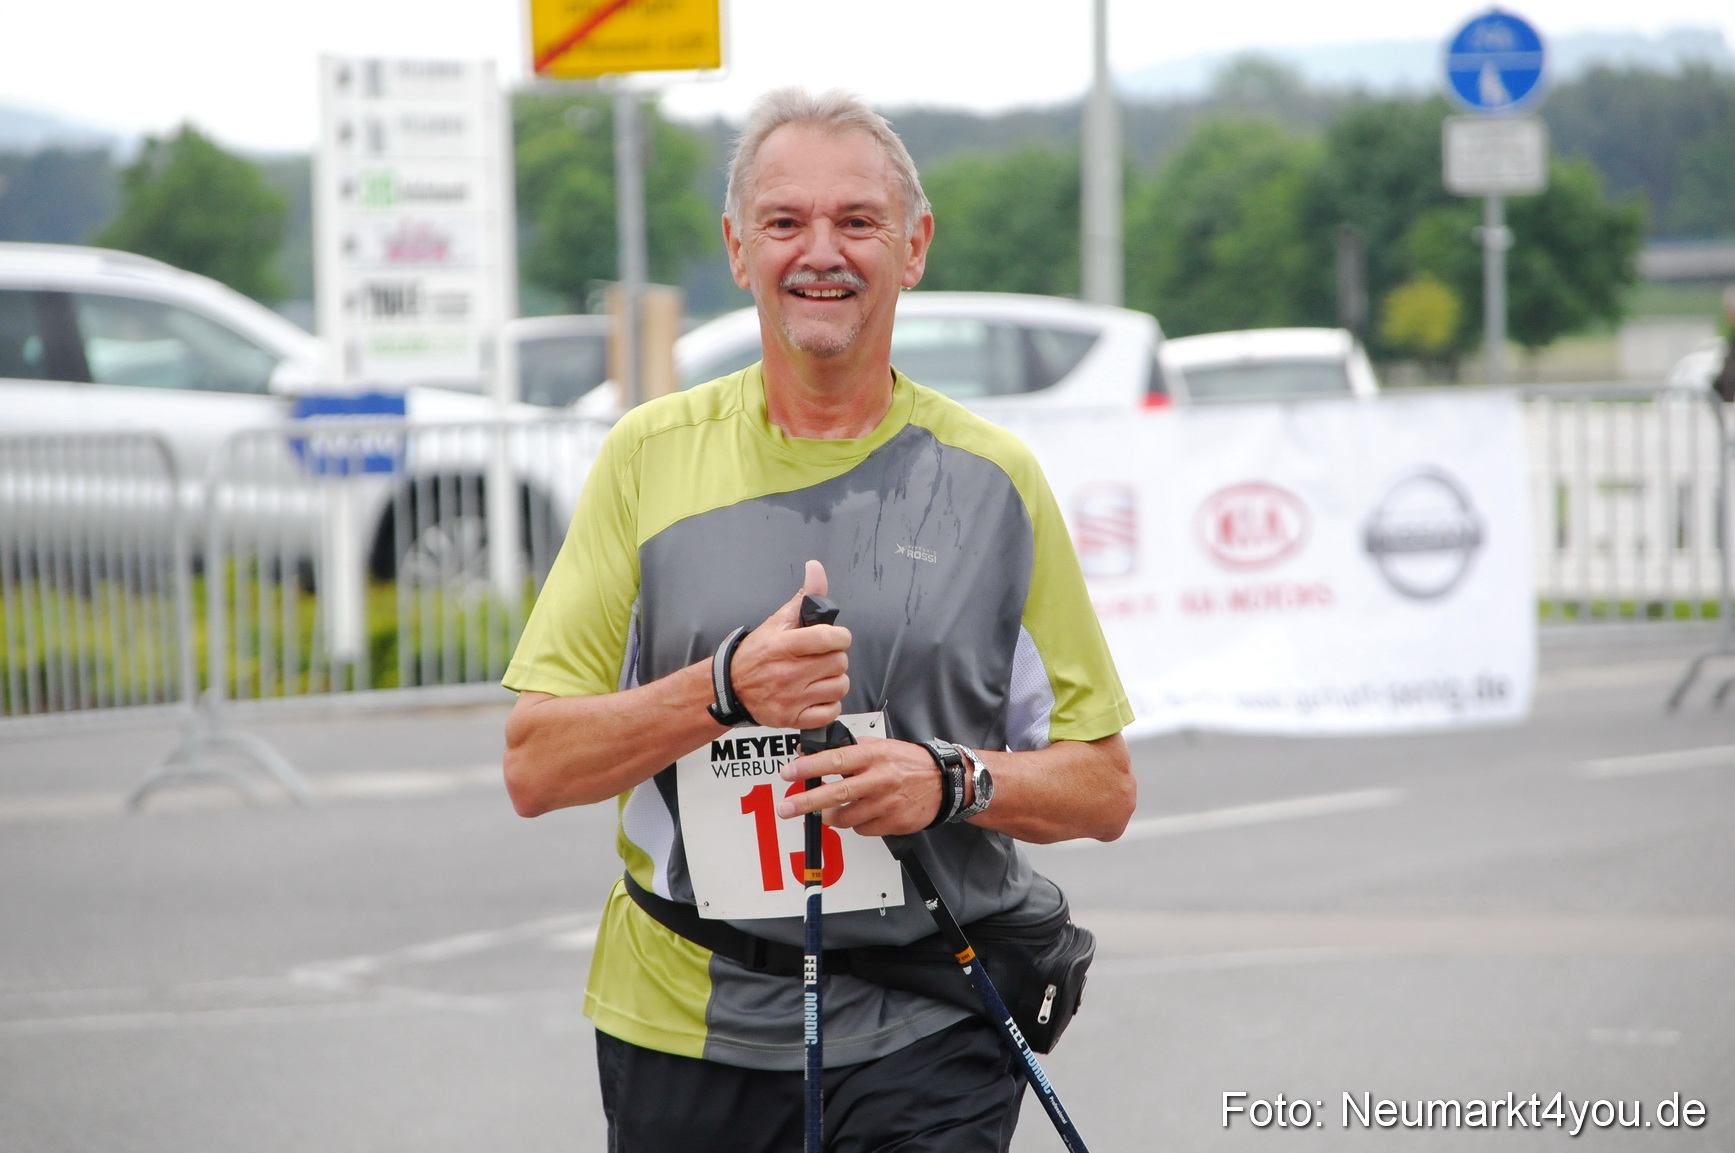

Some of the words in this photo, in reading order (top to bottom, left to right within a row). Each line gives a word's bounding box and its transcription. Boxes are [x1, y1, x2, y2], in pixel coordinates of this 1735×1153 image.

[907, 549, 937, 564] ROSSI
[711, 733, 801, 762] MEYER
[711, 756, 800, 779] WERBUN
[740, 781, 845, 892] 13
[803, 955, 818, 988] FEEL
[803, 992, 819, 1046] NORDIC
[1005, 1016, 1027, 1049] FEEL
[1048, 1095, 1068, 1125] Professional
